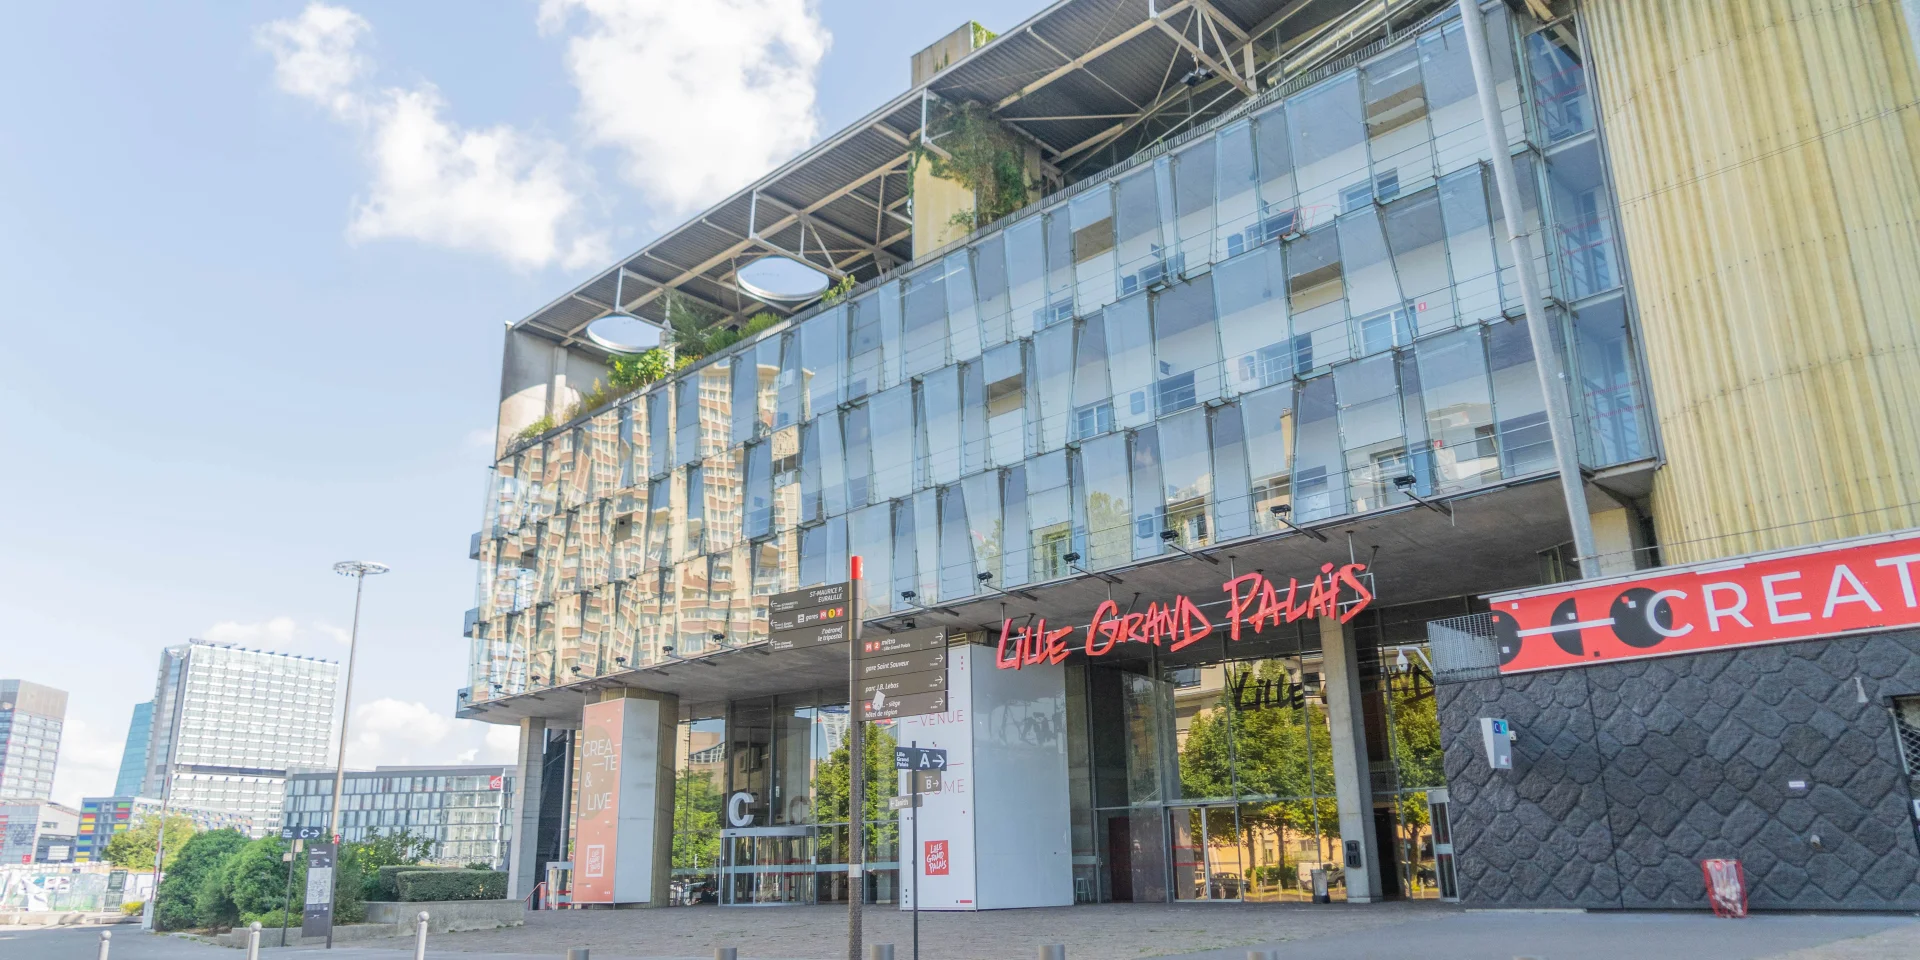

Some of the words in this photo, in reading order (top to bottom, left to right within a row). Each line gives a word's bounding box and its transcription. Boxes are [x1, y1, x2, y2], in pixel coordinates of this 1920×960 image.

[810, 588, 838, 598] ST-MAURICE
[818, 593, 842, 602] EURALILLE
[1645, 553, 1920, 638] CREAT
[806, 614, 818, 622] gares
[1085, 594, 1214, 657] GRAND
[823, 632, 842, 641] tripostal
[866, 664, 876, 673] gare
[890, 660, 909, 669] Sauveur
[920, 753, 930, 768] A
[585, 771, 592, 788] &
[926, 779, 932, 789] B
[587, 792, 612, 810] LIVE
[729, 792, 754, 826] C
[300, 829, 309, 838] C
